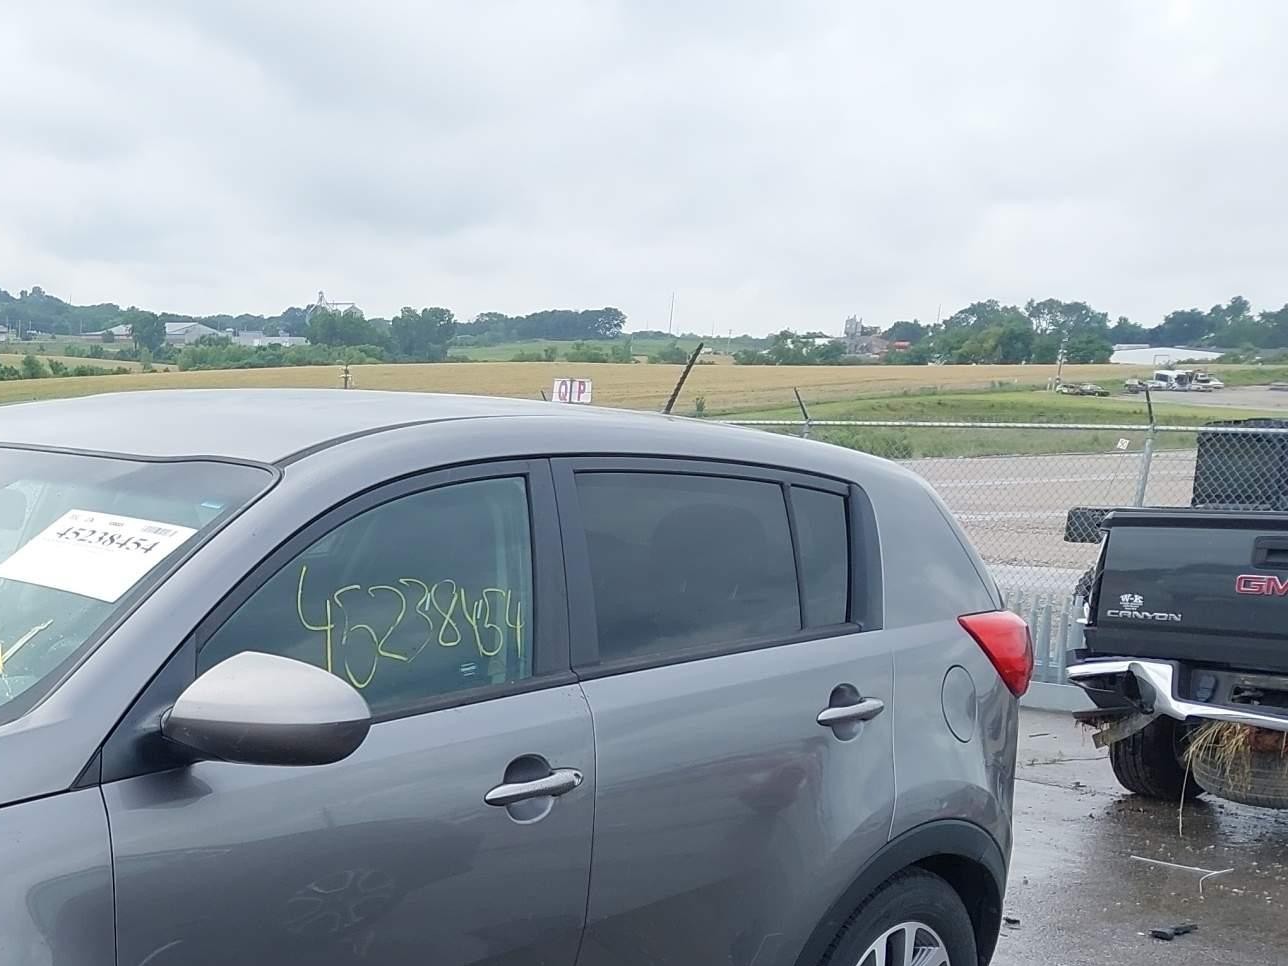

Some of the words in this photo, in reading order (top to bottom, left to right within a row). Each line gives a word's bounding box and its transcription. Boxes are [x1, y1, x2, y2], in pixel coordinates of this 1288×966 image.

[577, 380, 586, 401] P
[56, 526, 161, 554] 45238454
[1107, 609, 1182, 621] CANYON
[297, 566, 526, 689] 45238454
